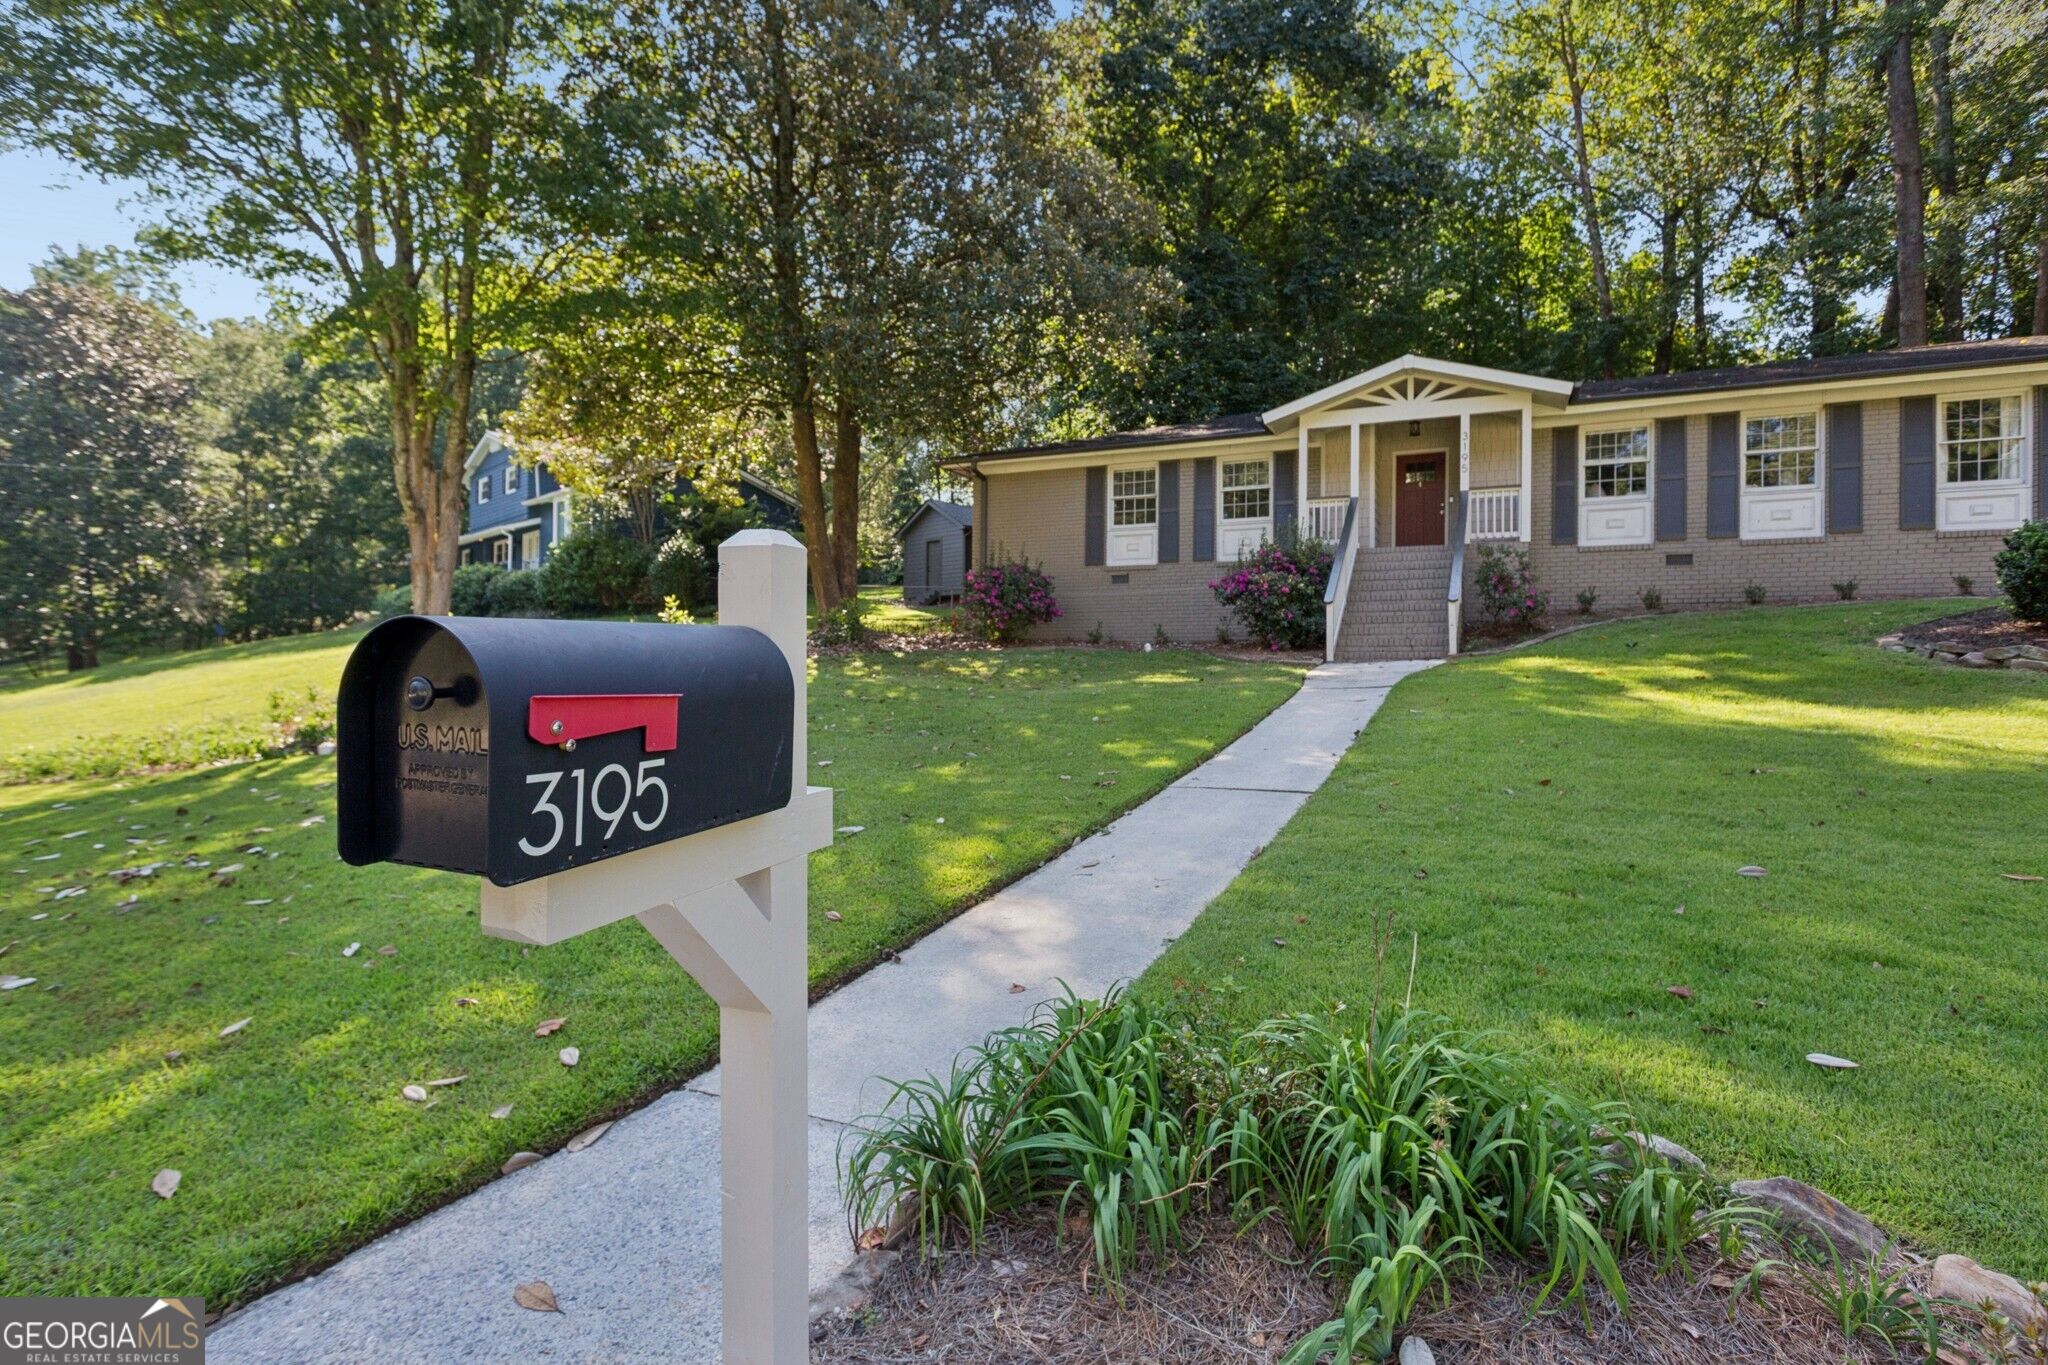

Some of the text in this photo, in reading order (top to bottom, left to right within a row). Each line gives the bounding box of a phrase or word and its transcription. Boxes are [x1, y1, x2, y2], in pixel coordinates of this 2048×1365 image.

[398, 723, 488, 756] U.S. MAIL
[408, 762, 474, 780] APPROVED BY
[518, 758, 669, 857] 3195
